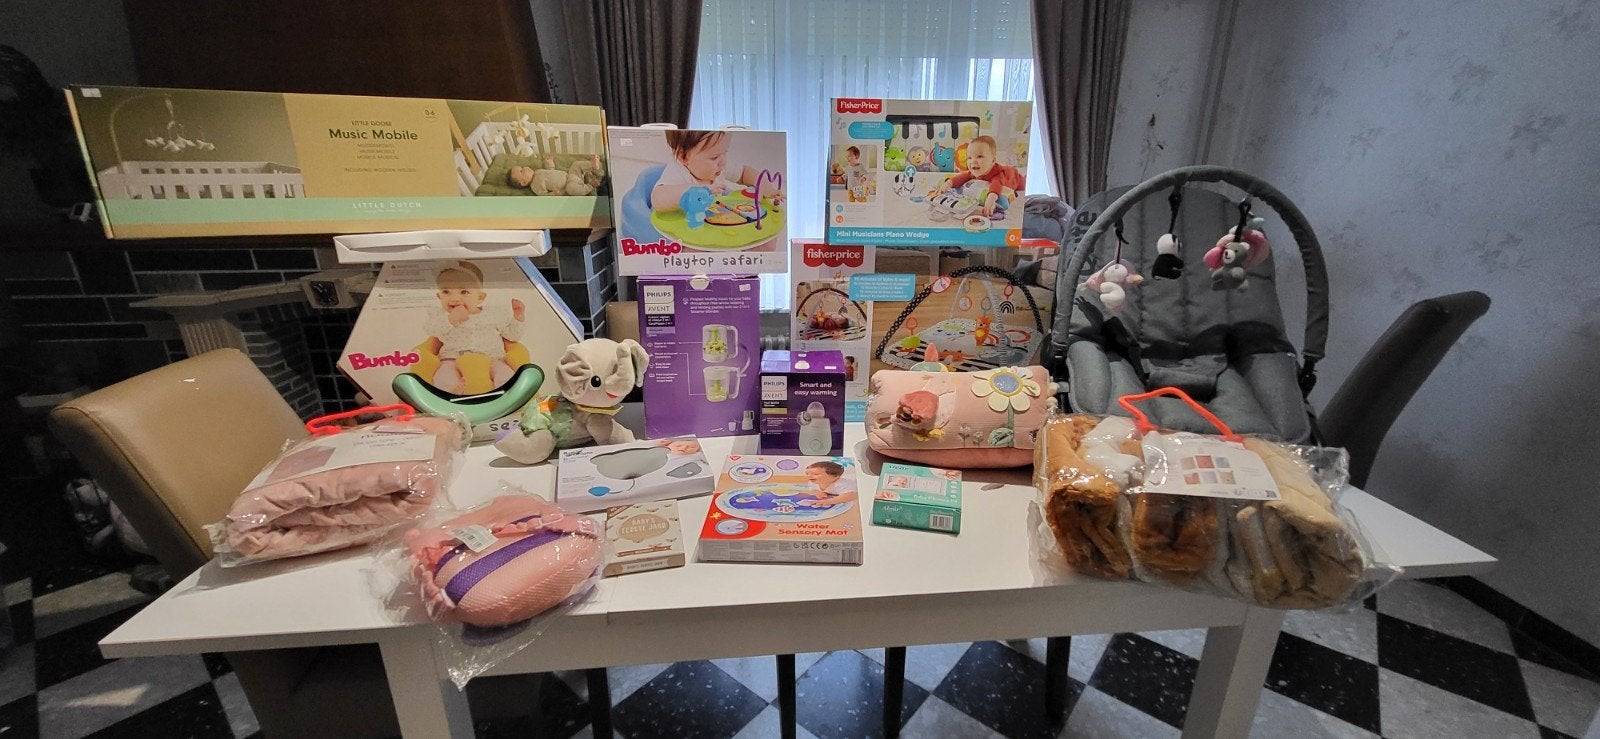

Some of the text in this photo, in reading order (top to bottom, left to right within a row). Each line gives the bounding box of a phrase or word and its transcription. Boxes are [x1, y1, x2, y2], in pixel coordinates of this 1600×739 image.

[840, 101, 879, 110] Fisher-Price
[328, 128, 418, 141] Music Mobile
[352, 201, 422, 209] LITTLE DUTCH
[621, 239, 682, 256] Bumbo
[807, 248, 861, 260] fisher-price
[663, 255, 714, 268] playtop
[722, 254, 763, 265] safari
[348, 351, 420, 370] Bumbo
[809, 389, 837, 397] warming
